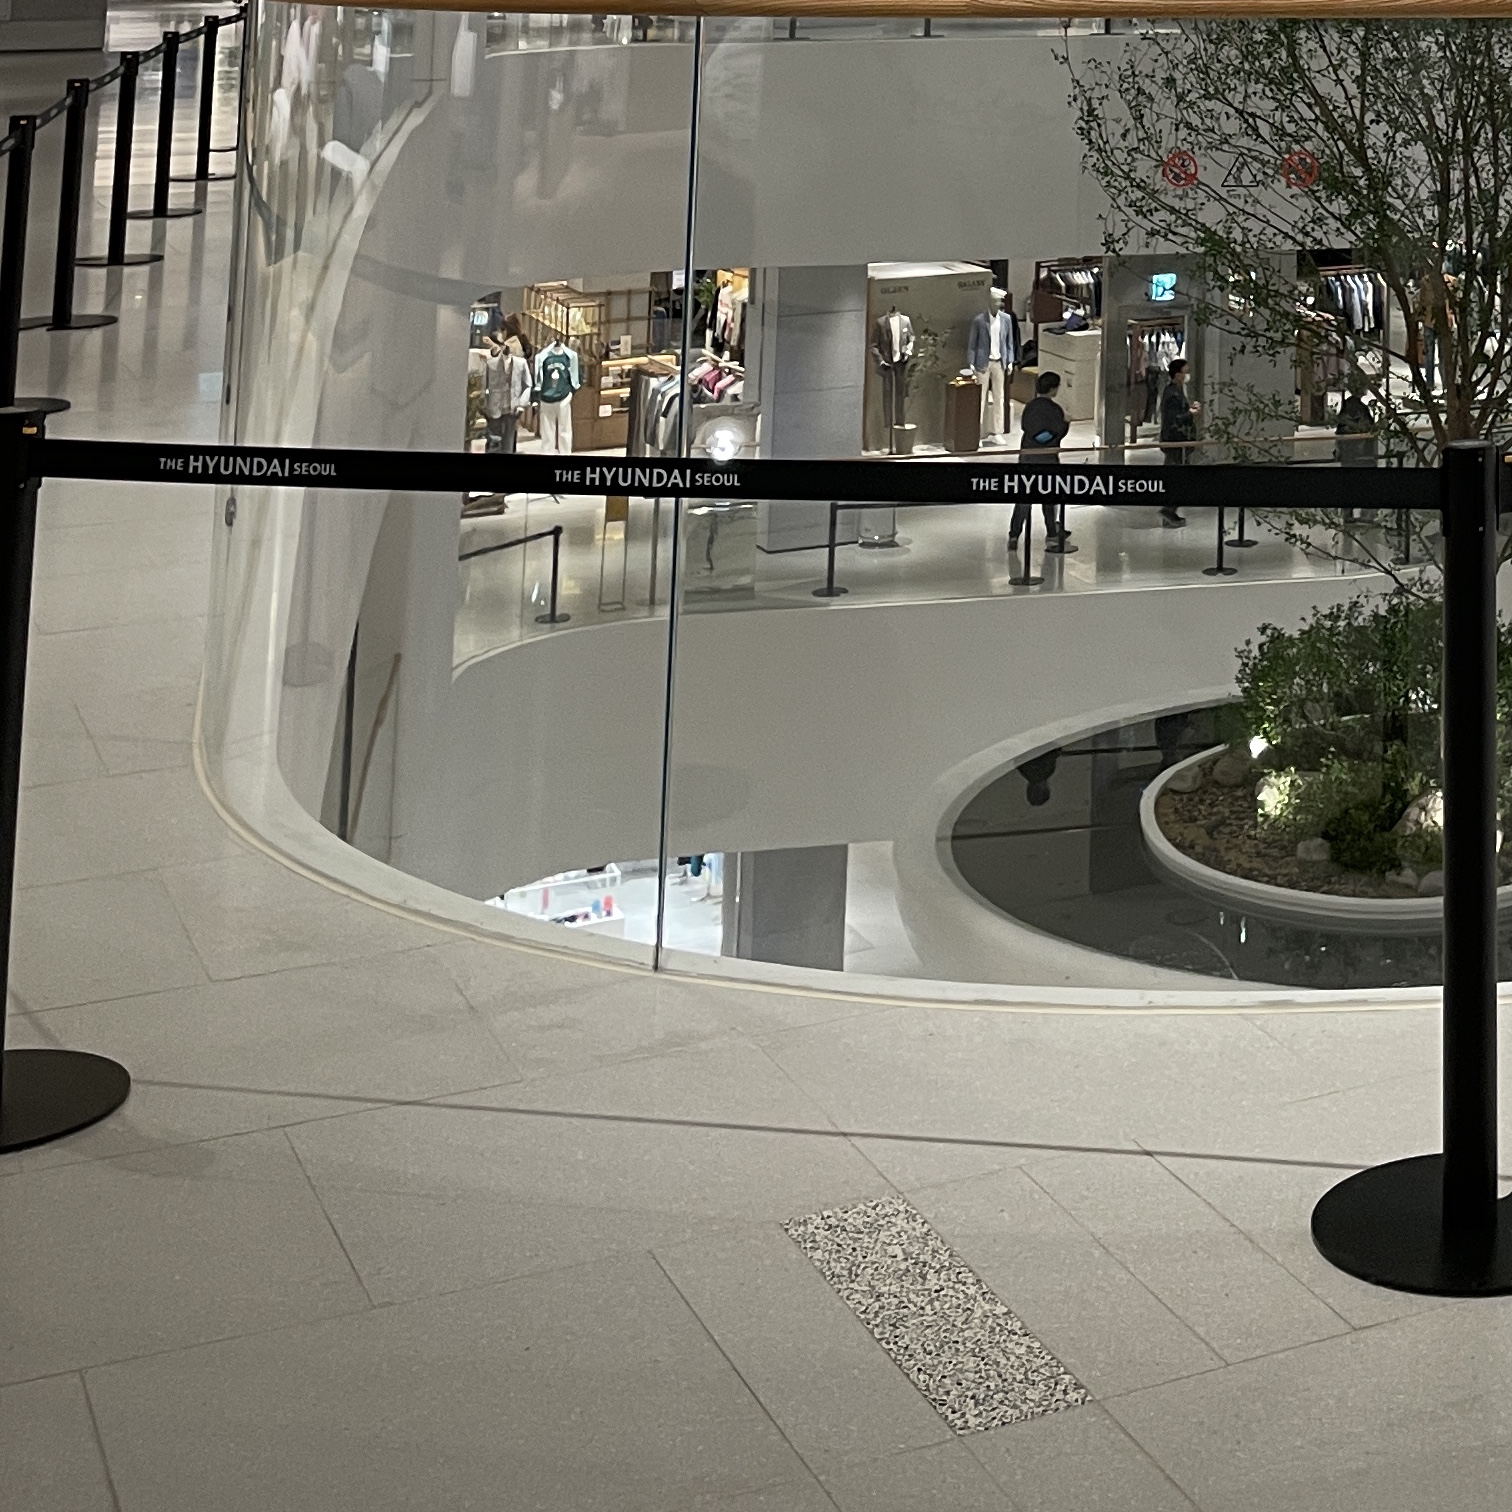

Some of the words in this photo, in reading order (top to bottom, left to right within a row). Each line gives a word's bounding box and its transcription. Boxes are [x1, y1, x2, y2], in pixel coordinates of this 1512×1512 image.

[159, 457, 184, 471] THE
[188, 454, 290, 477] HYUNDAI
[293, 462, 337, 476] SEOUL
[554, 469, 581, 483] THE
[585, 466, 691, 488] HYUNDAI
[695, 472, 741, 486] SEOUL
[971, 477, 999, 491] THE
[1003, 474, 1114, 496] HYUNDAI
[1118, 479, 1166, 493] SEOUL
